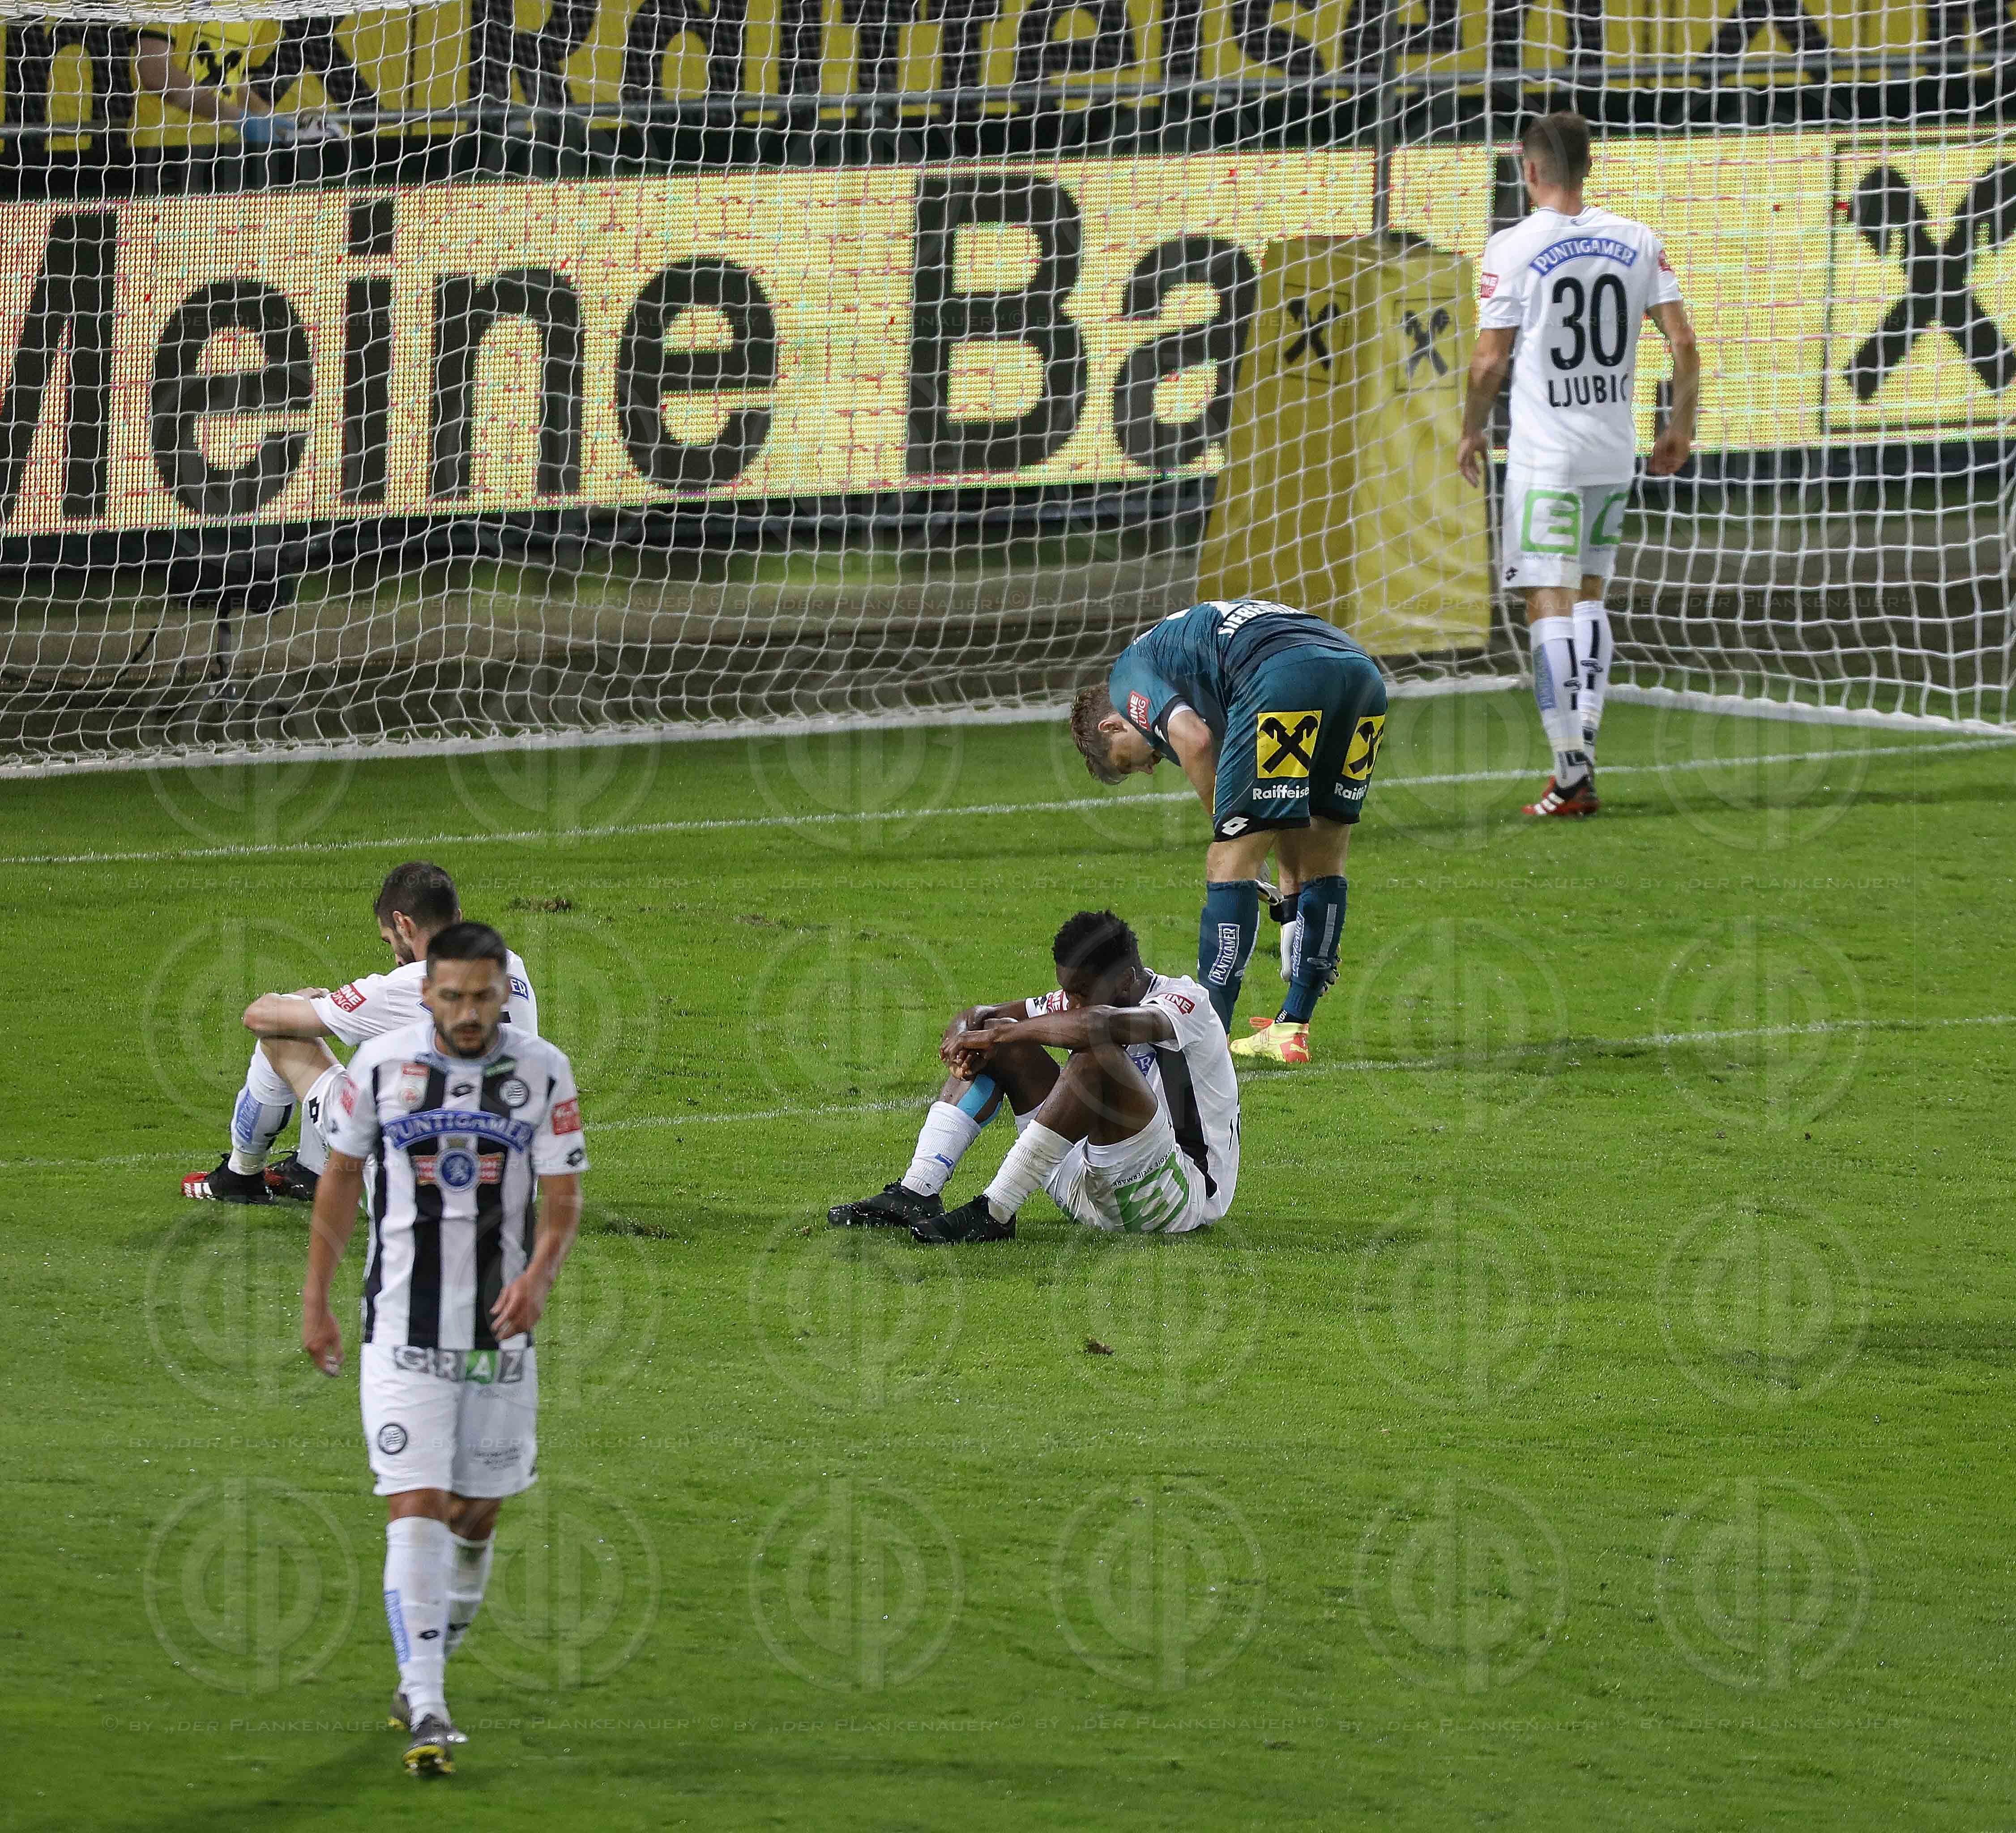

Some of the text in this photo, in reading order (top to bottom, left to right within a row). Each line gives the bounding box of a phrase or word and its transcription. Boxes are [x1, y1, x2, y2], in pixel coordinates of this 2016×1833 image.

[1537, 238, 1633, 270] PUNTIGAMER
[1550, 273, 1629, 371] 30
[386, 1113, 533, 1144] PUNTIGAMER
